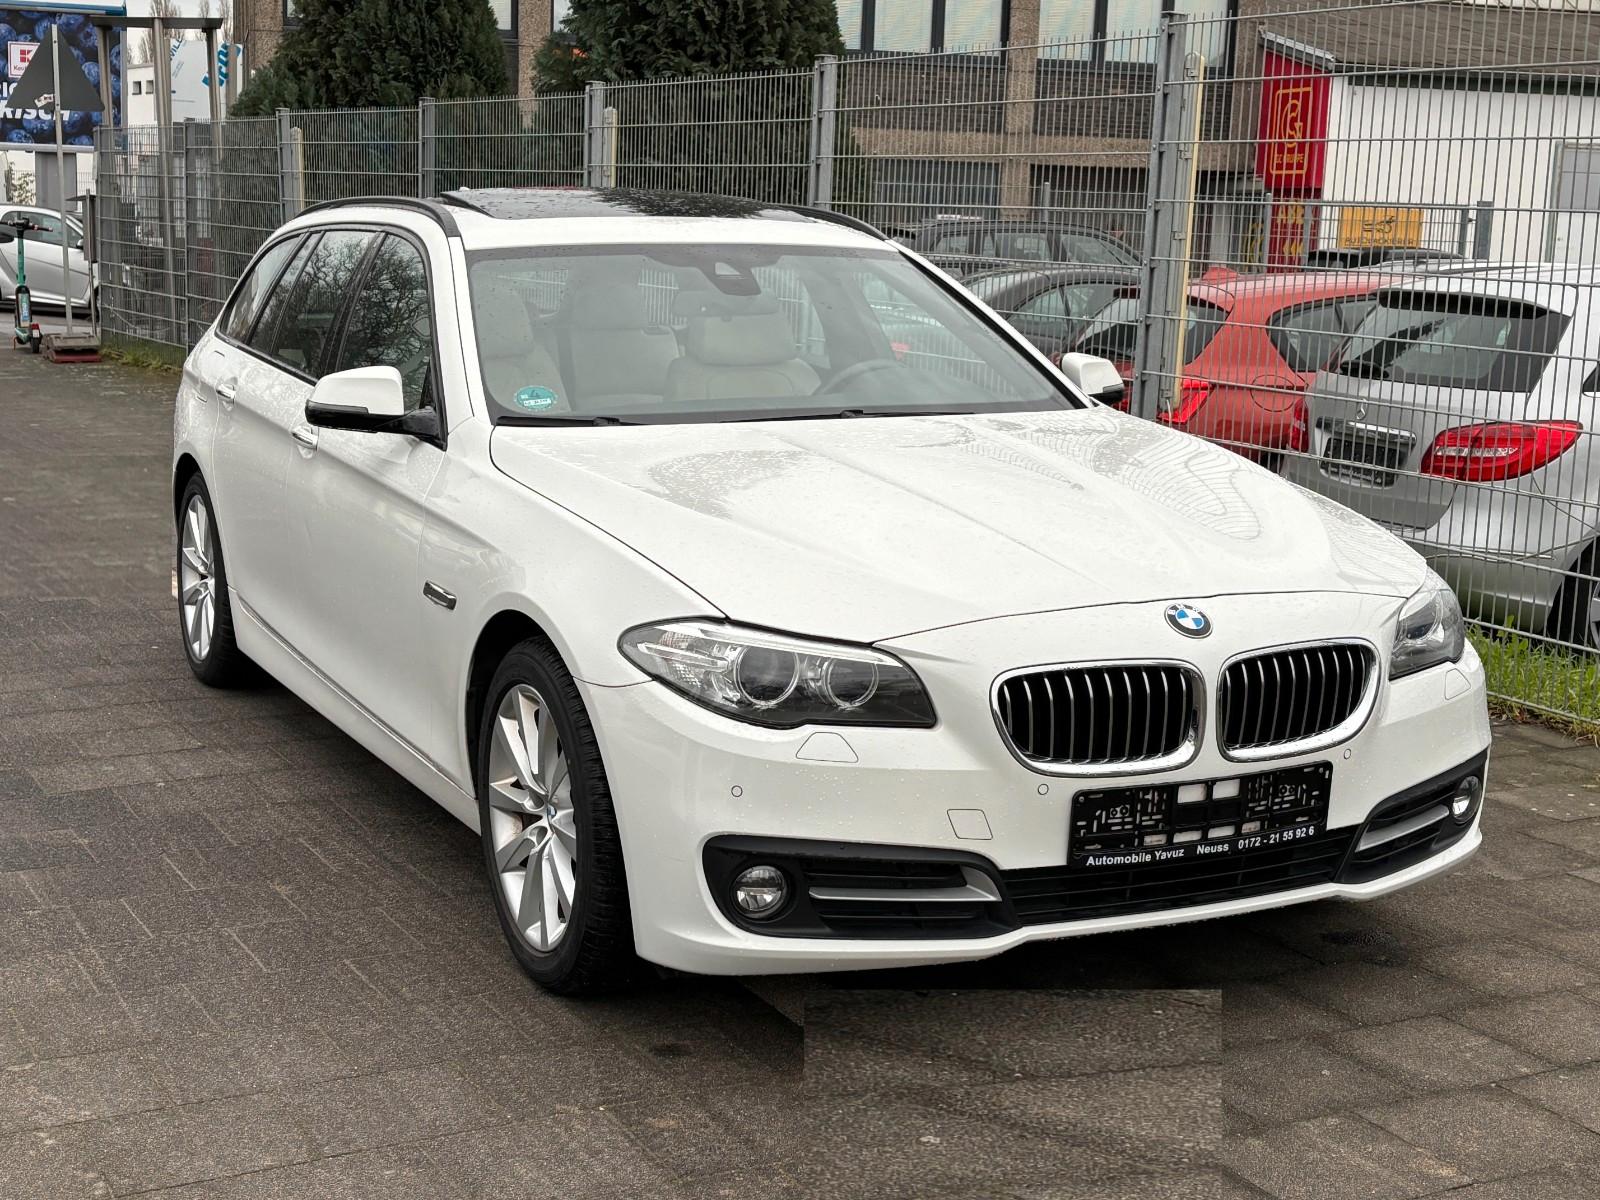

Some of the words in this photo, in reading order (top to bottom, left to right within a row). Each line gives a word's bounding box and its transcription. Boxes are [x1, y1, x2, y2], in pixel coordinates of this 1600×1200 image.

[1086, 852, 1151, 866] Automobile
[1154, 848, 1185, 860] Yavuz
[1196, 843, 1229, 855] Neuss
[1238, 836, 1261, 849] 0172
[1269, 832, 1280, 844] 21
[1282, 829, 1294, 841] 55
[1295, 827, 1307, 839] 92
[1308, 825, 1315, 836] 6
